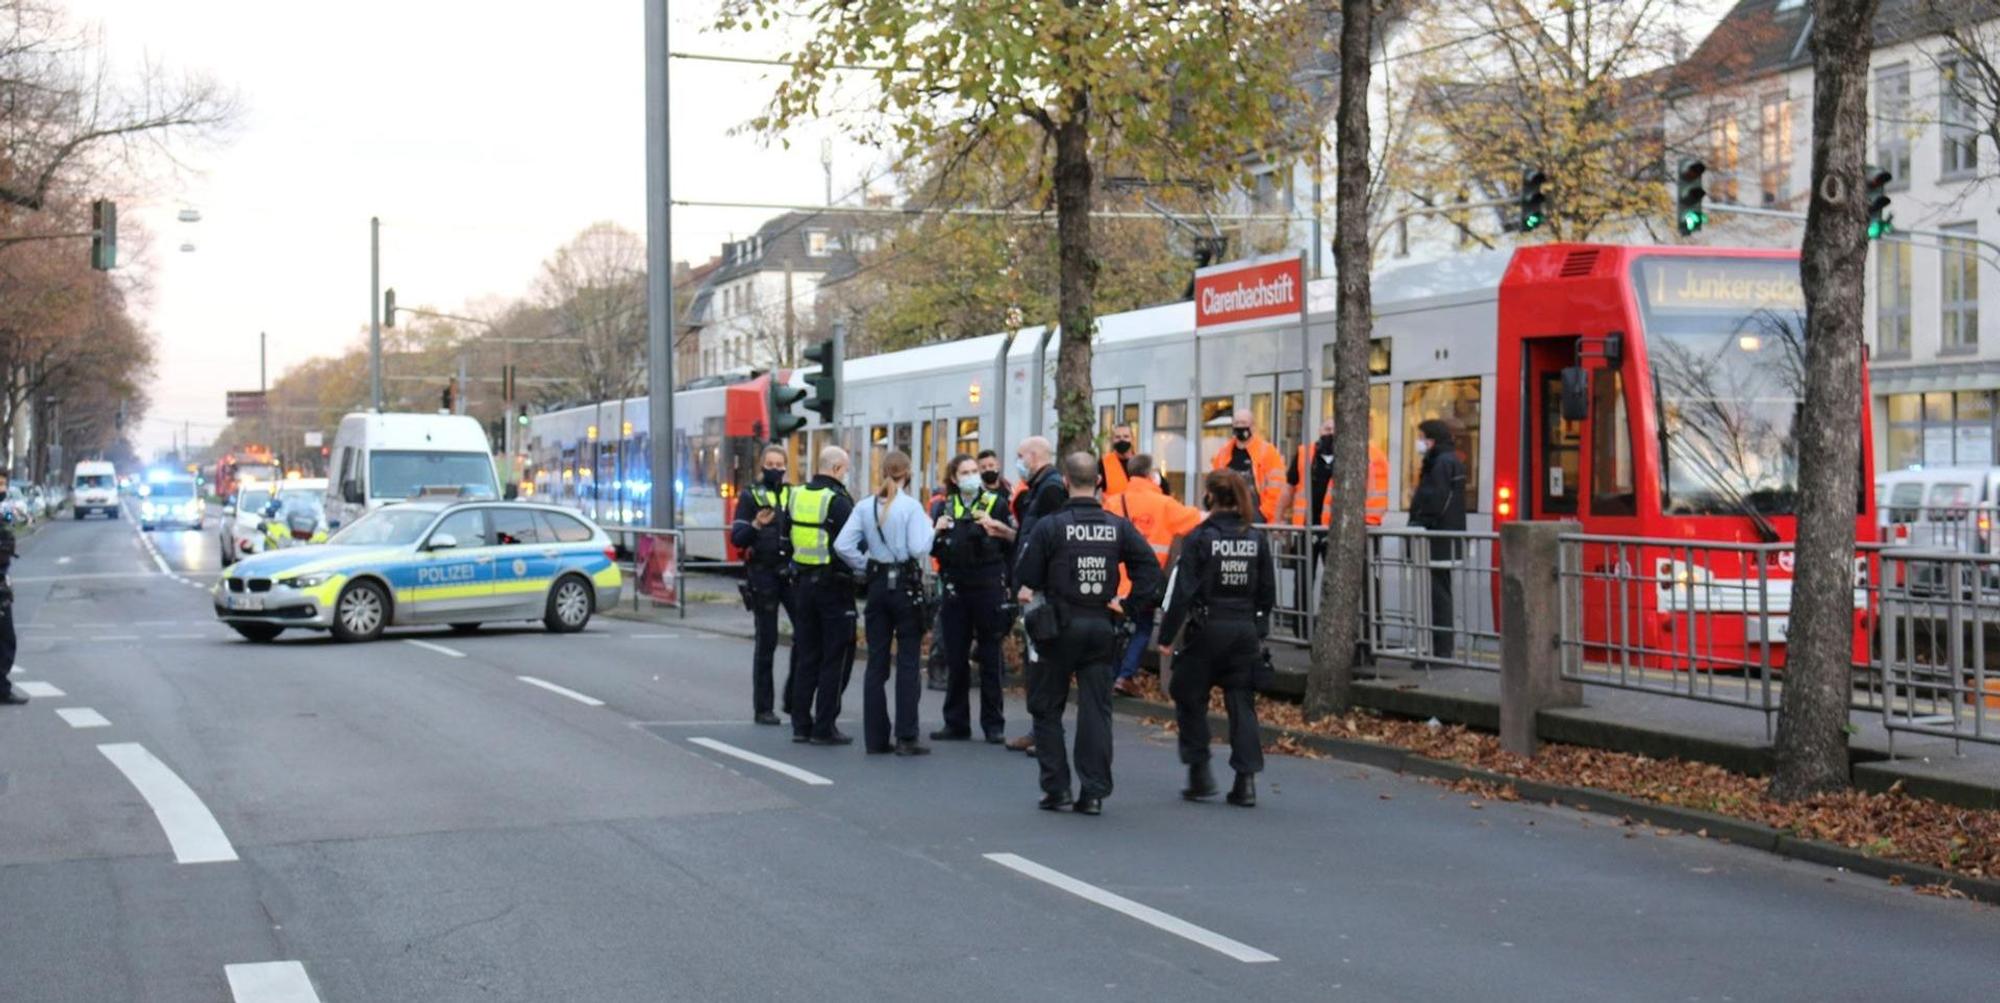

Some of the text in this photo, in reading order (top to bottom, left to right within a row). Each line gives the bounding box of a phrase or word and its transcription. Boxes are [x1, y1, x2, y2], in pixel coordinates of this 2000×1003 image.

[1203, 273, 1294, 315] Clarenbachstift
[1679, 269, 1802, 302] Junkersdo
[1066, 524, 1117, 541] POLIZEI
[1211, 539, 1259, 556] POLIZEI
[1077, 556, 1107, 569] NRW
[1220, 560, 1248, 573] NRW
[418, 564, 475, 584] POLIZEI
[1078, 570, 1107, 582] 31211
[1221, 573, 1248, 585] 31211
